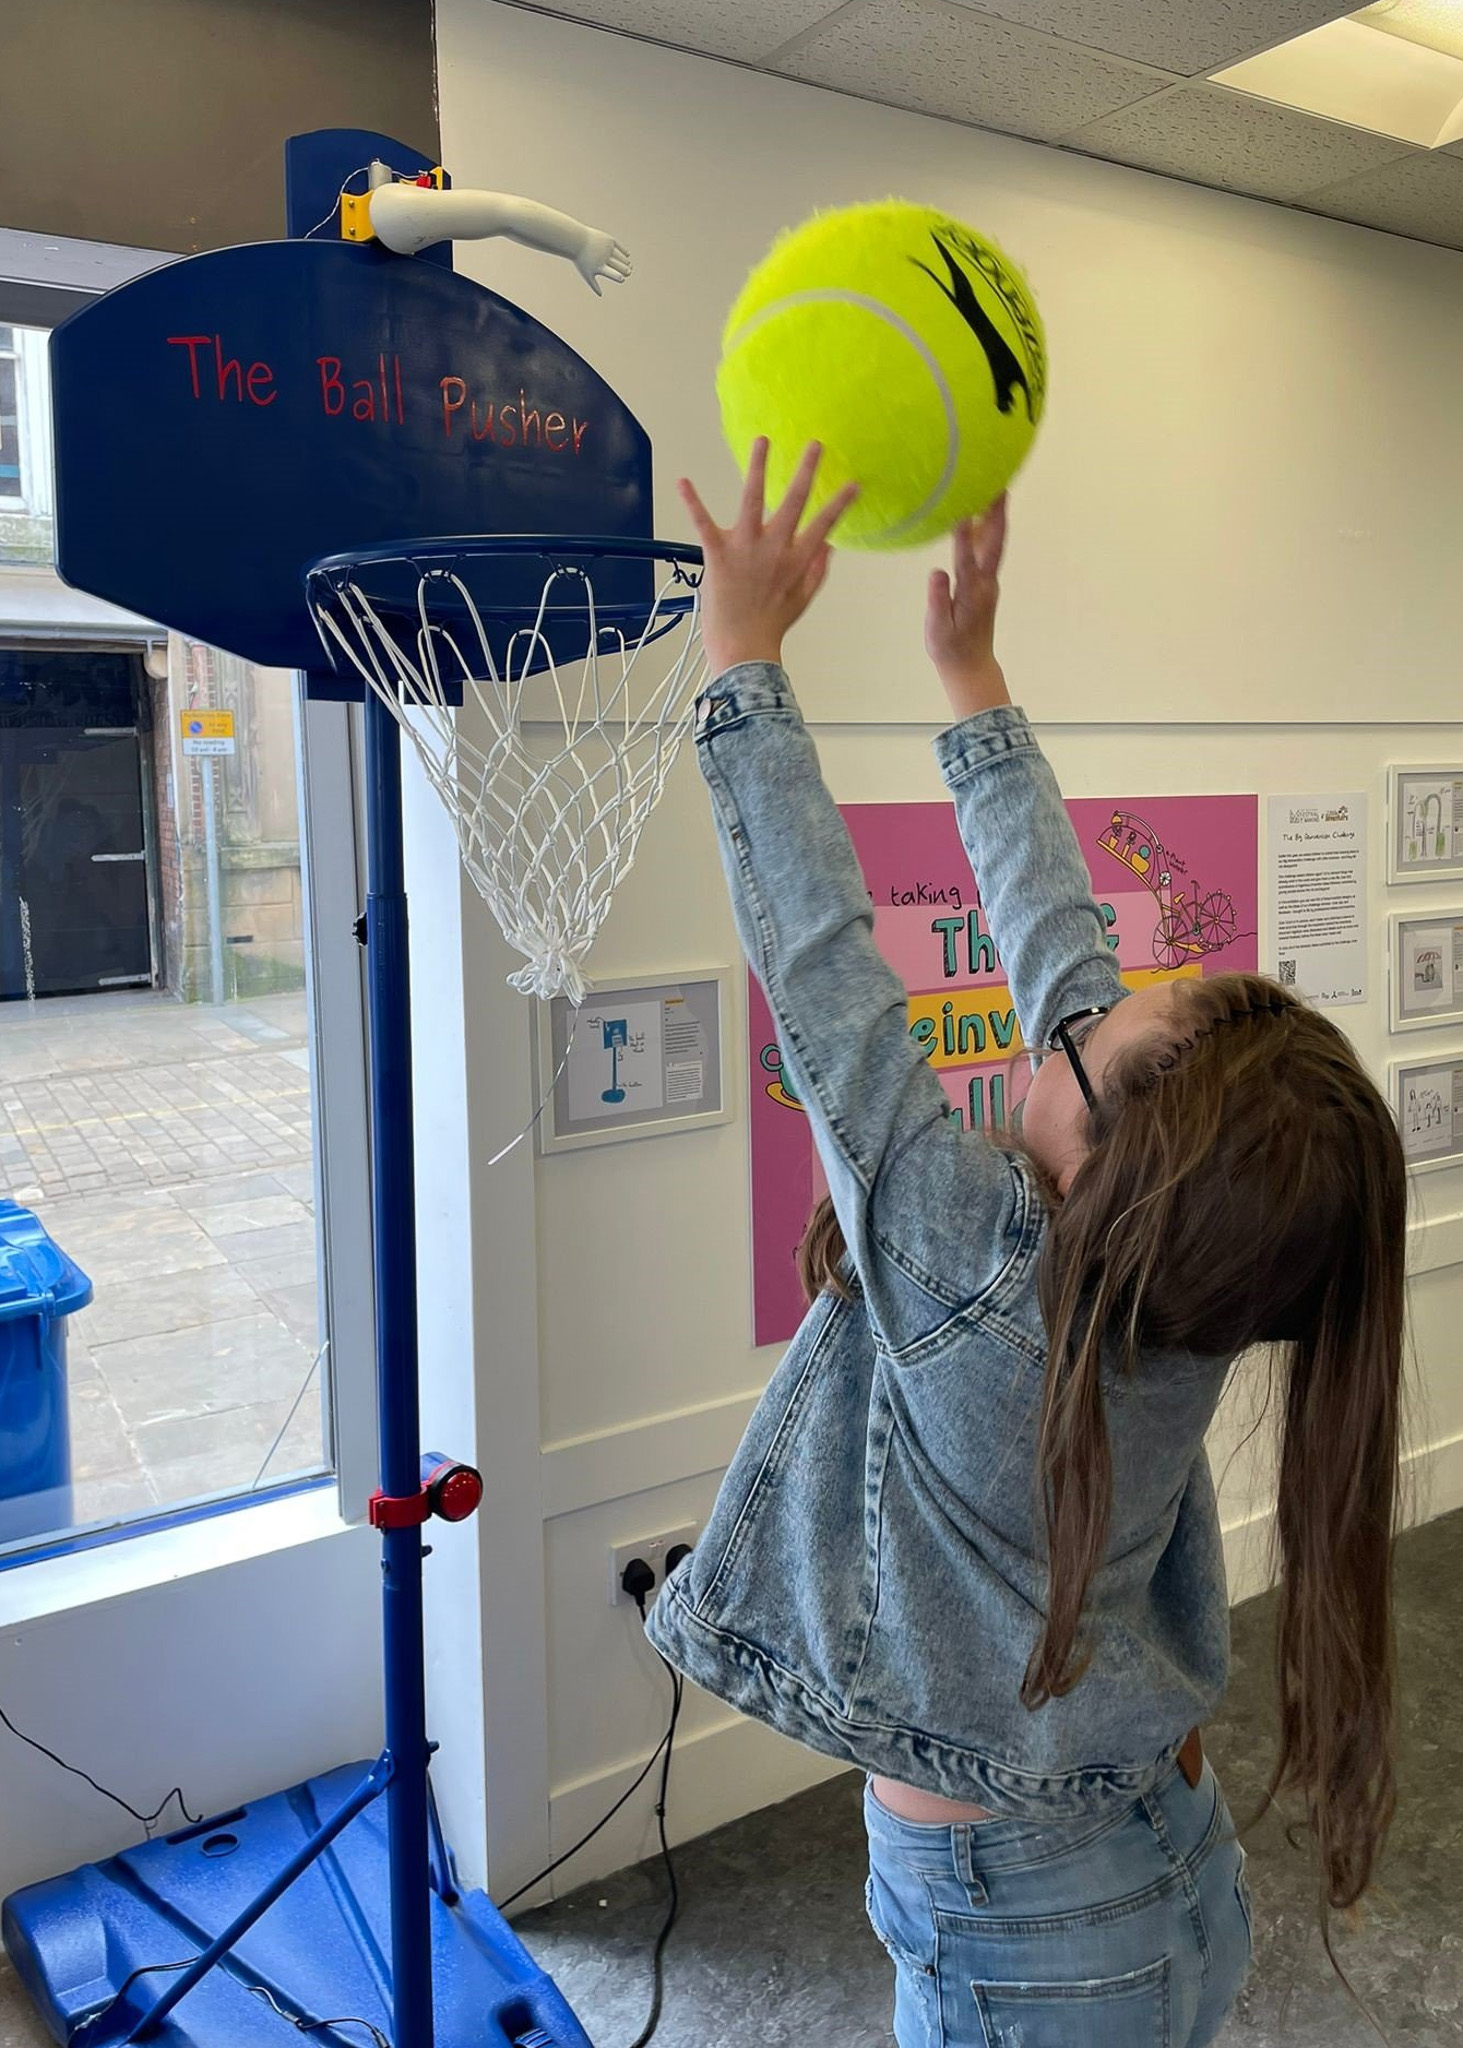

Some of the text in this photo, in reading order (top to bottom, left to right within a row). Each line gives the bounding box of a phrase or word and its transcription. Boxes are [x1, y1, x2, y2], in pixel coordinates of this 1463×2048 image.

[166, 334, 590, 457] The Ball Pusher
[891, 882, 962, 910] taking
[931, 910, 1003, 978] Th
[909, 1001, 1023, 1057] einv
